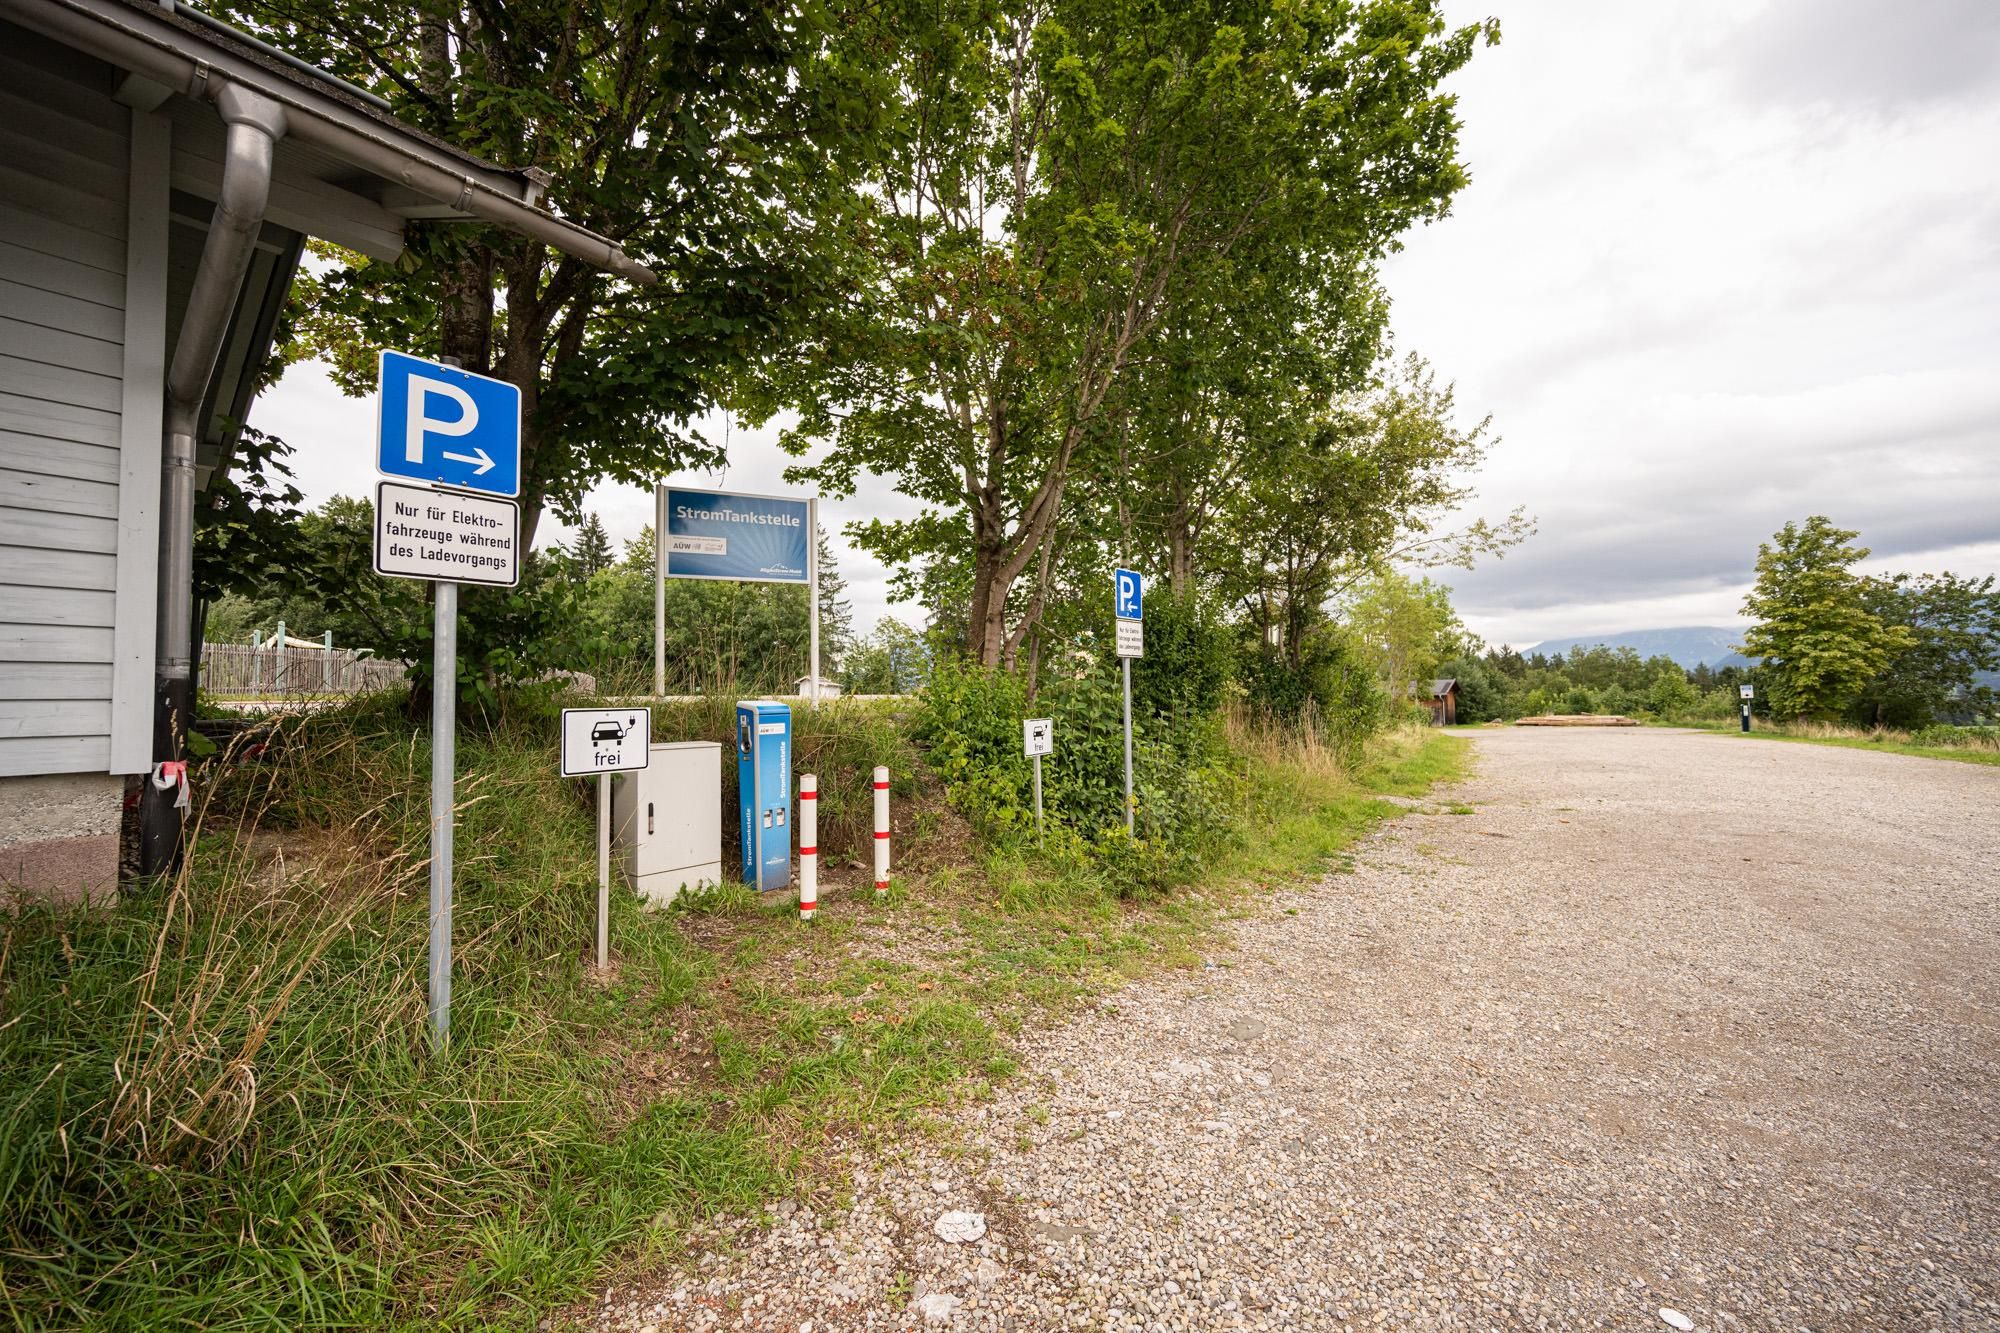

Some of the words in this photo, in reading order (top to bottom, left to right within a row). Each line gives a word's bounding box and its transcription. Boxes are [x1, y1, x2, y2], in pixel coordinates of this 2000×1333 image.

[405, 373, 479, 464] P
[395, 502, 419, 517] Nur
[426, 507, 446, 521] für
[452, 510, 503, 528] Elektro-
[676, 505, 800, 527] StromTankstelle
[386, 522, 453, 544] fahrzeuge
[460, 533, 511, 549] während
[389, 543, 414, 558] des
[420, 546, 507, 570] Ladevorgangs
[1120, 575, 1134, 611] P
[594, 750, 620, 766] frei
